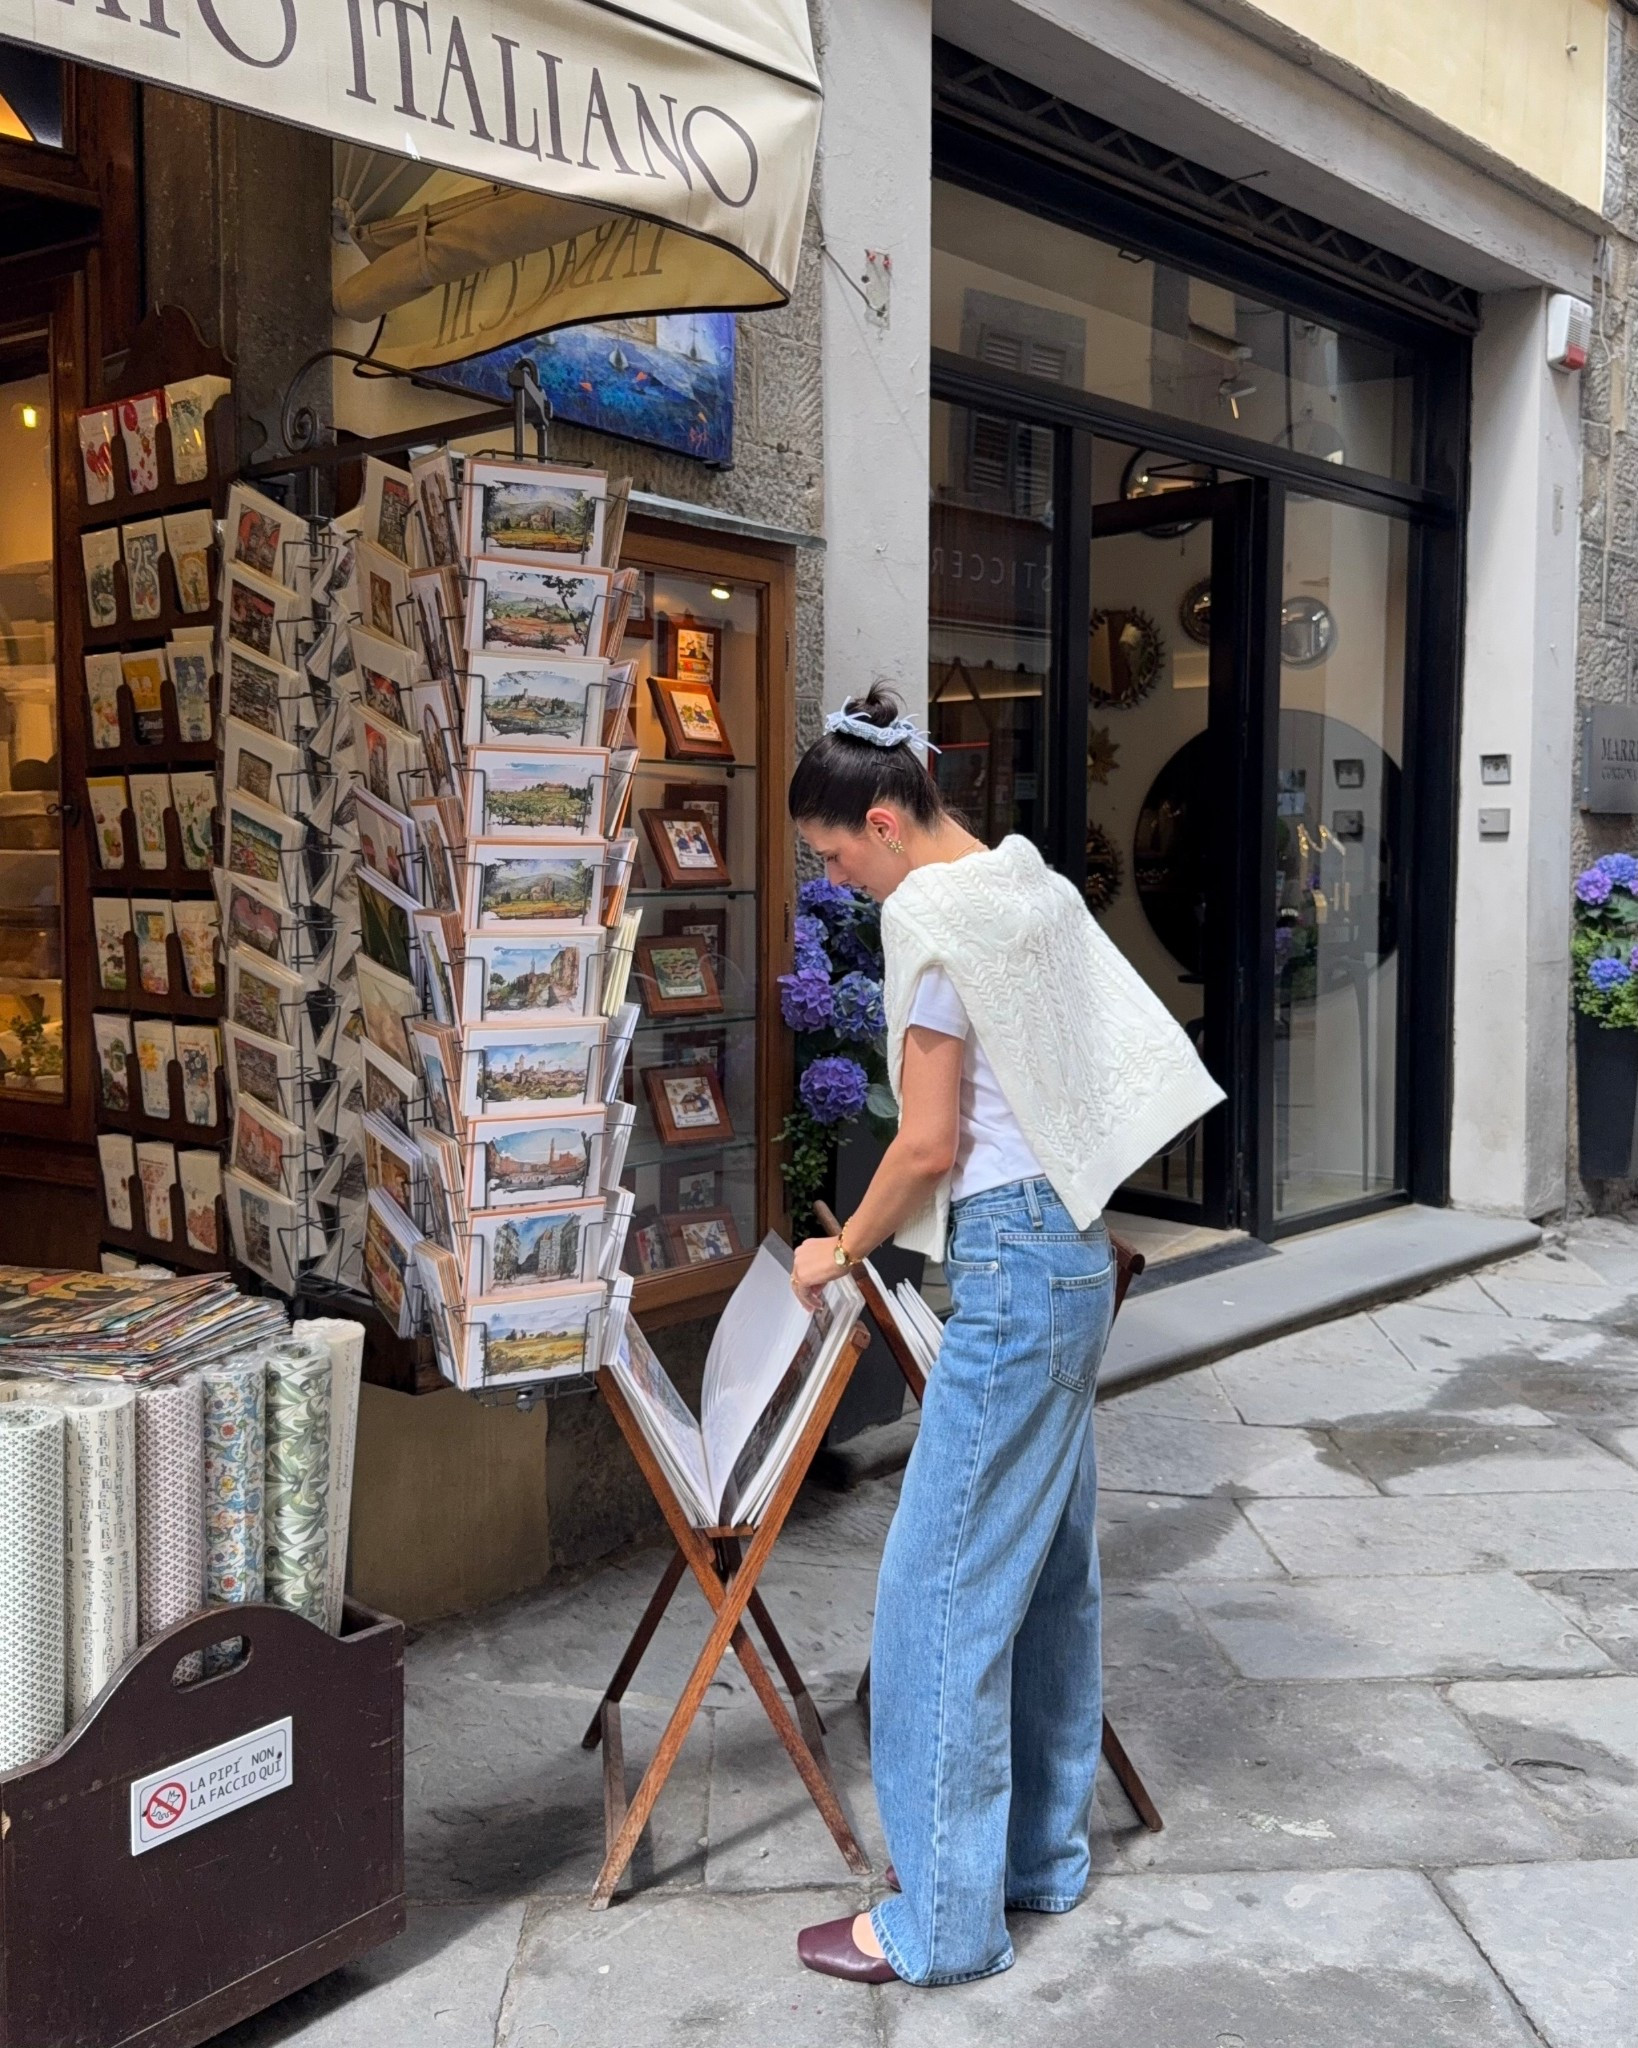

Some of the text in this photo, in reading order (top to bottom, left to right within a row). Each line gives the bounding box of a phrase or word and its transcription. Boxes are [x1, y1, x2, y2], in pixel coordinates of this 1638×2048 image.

[346, 0, 758, 208] ITALIANO
[1601, 736, 1638, 762] MARR
[190, 1777, 206, 1793] LA
[251, 1746, 275, 1766] NON
[190, 1794, 206, 1811] LA
[209, 1771, 256, 1802] FACCIO
